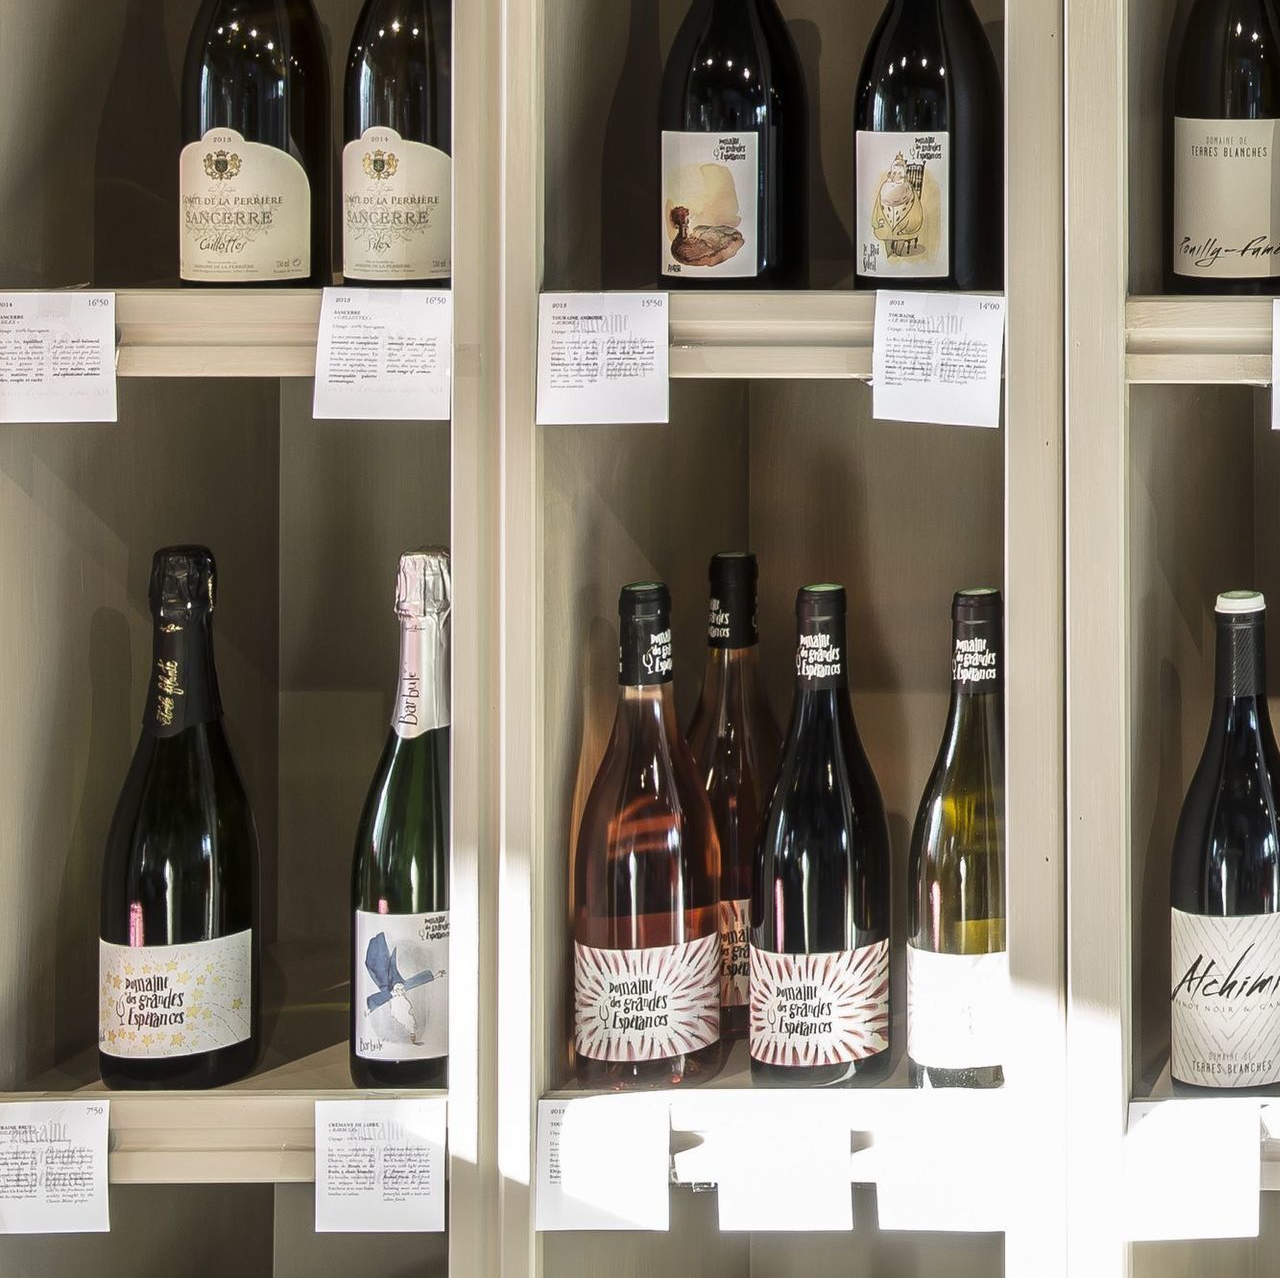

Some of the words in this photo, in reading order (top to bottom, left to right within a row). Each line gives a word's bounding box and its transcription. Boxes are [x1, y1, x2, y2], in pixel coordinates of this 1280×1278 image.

[1191, 146, 1220, 158] TERRES
[1224, 146, 1268, 158] BLANCHES
[204, 197, 215, 205] DE
[216, 196, 230, 205] LA
[185, 210, 273, 224] SANCERRE
[347, 210, 429, 224] SANCERRE
[125, 975, 169, 992] Domaine
[608, 979, 653, 996] Domaine
[126, 993, 137, 1006] des
[138, 988, 184, 1009] grandes
[776, 984, 818, 1000] Domaine
[610, 997, 622, 1009] des
[623, 993, 669, 1013] grandes
[777, 1001, 788, 1013] des
[789, 998, 833, 1018] grandes
[1205, 1004, 1232, 1013] NOIR
[1192, 1059, 1223, 1072] TERRES
[1227, 1059, 1272, 1074] BLANCHES
